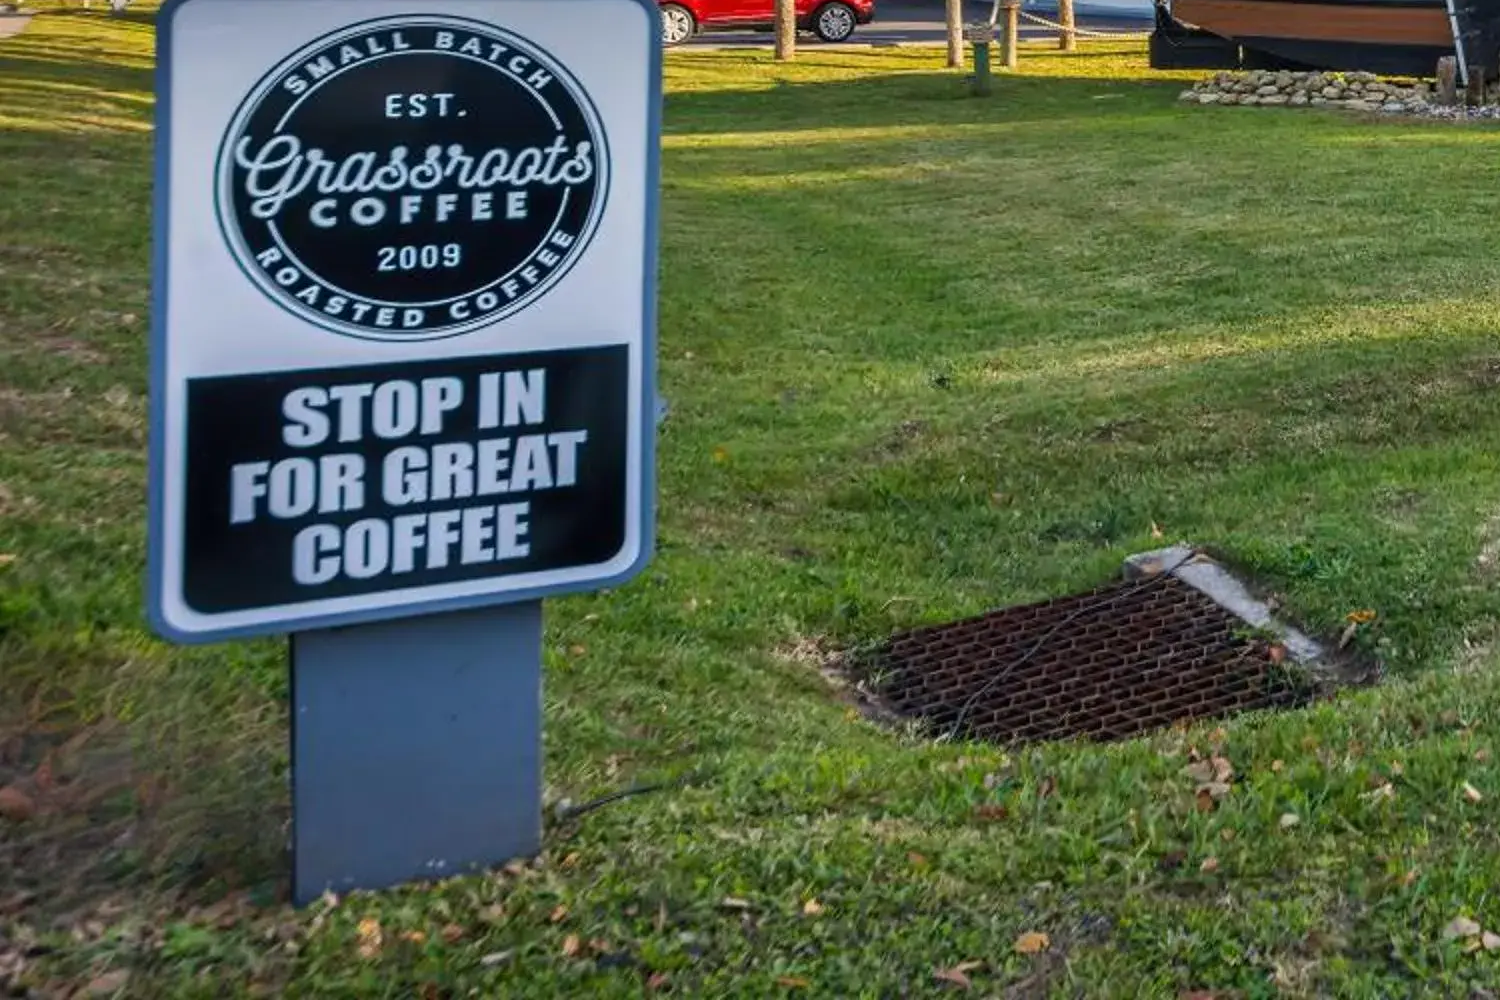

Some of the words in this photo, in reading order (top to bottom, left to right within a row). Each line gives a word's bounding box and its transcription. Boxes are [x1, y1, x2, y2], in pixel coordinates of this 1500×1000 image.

[284, 31, 410, 96] SMALL
[434, 30, 553, 89] BATCH
[385, 93, 467, 119] EST.
[235, 134, 594, 220] Grassroots
[309, 191, 528, 227] COFFEE
[256, 246, 424, 328] ROASTED
[450, 229, 574, 320] COFFEE
[377, 244, 462, 272] 2009
[282, 376, 464, 448] STOP
[478, 368, 546, 430] IN
[230, 452, 366, 525] FOR
[382, 429, 588, 506] GREAT
[292, 501, 531, 586] COFFEE
